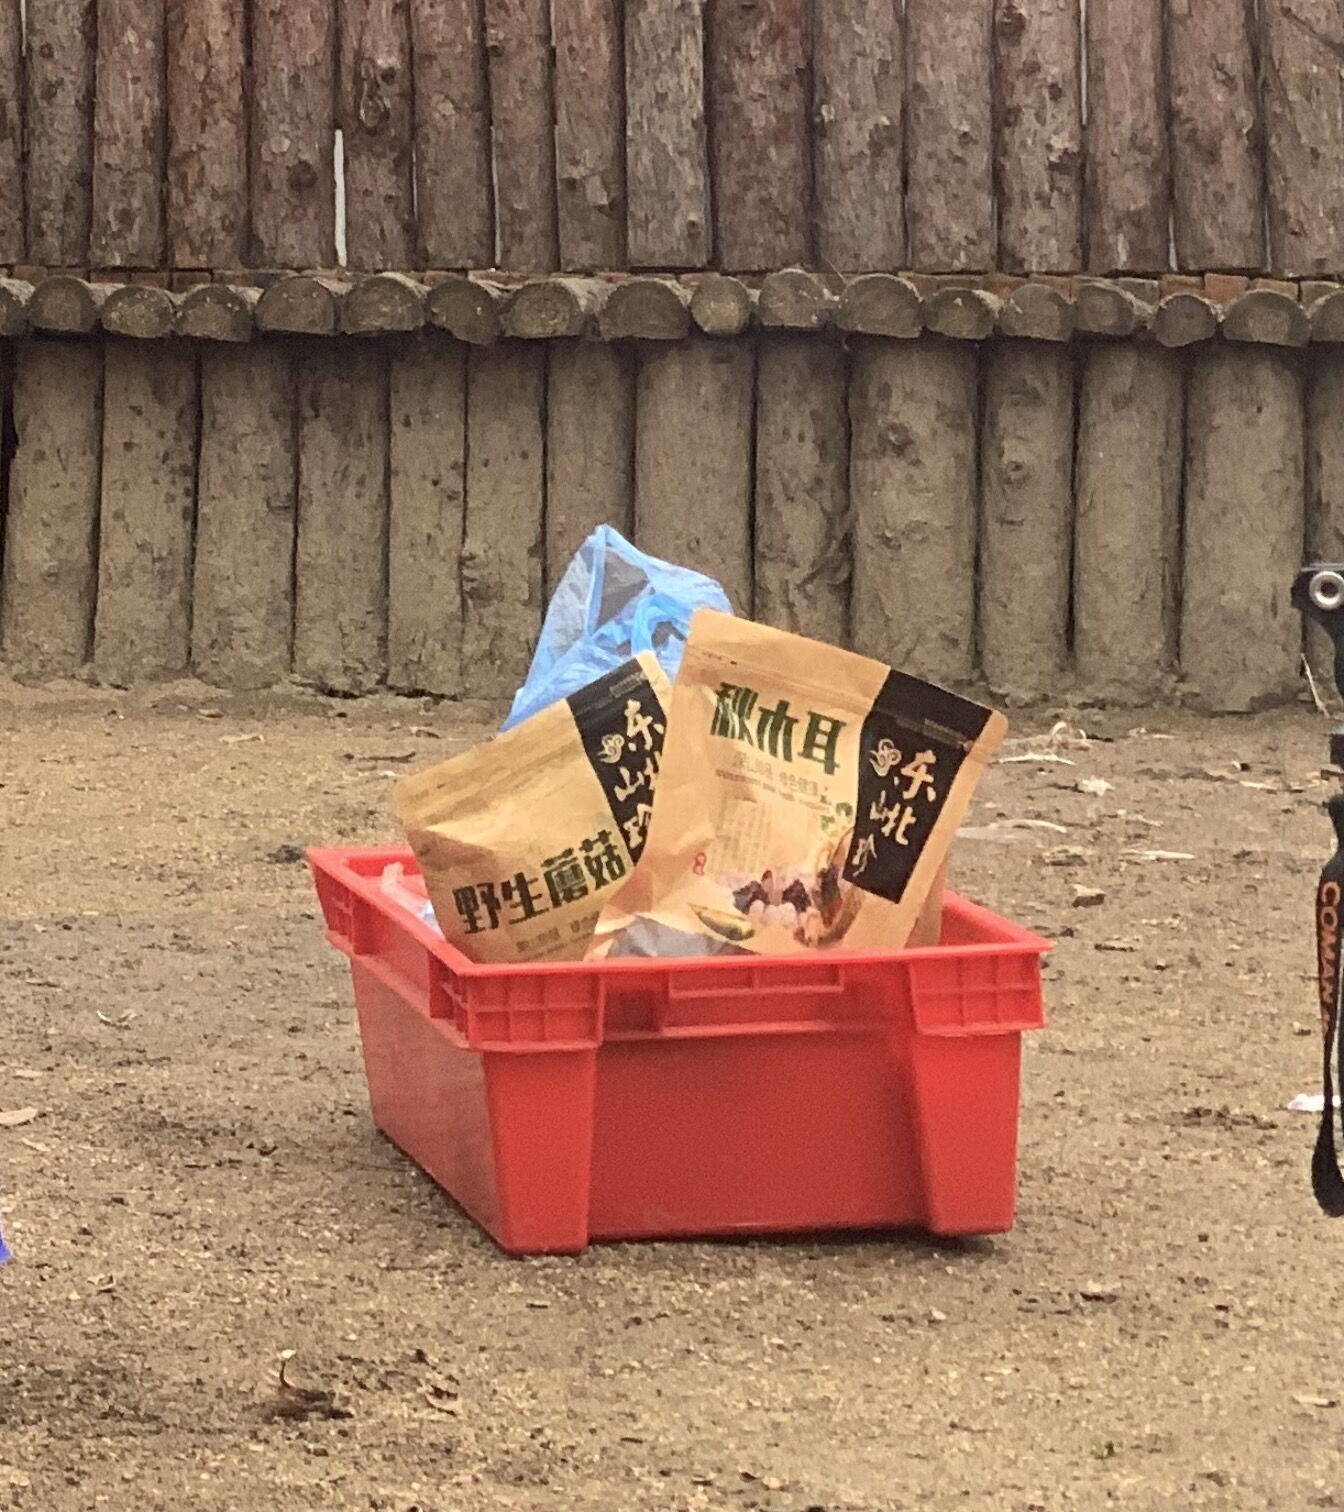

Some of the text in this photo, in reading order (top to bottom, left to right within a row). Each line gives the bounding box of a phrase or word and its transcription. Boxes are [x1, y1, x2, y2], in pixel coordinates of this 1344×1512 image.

[710, 682, 847, 776] 秋木耳
[452, 829, 627, 935] 野生蘑菇
